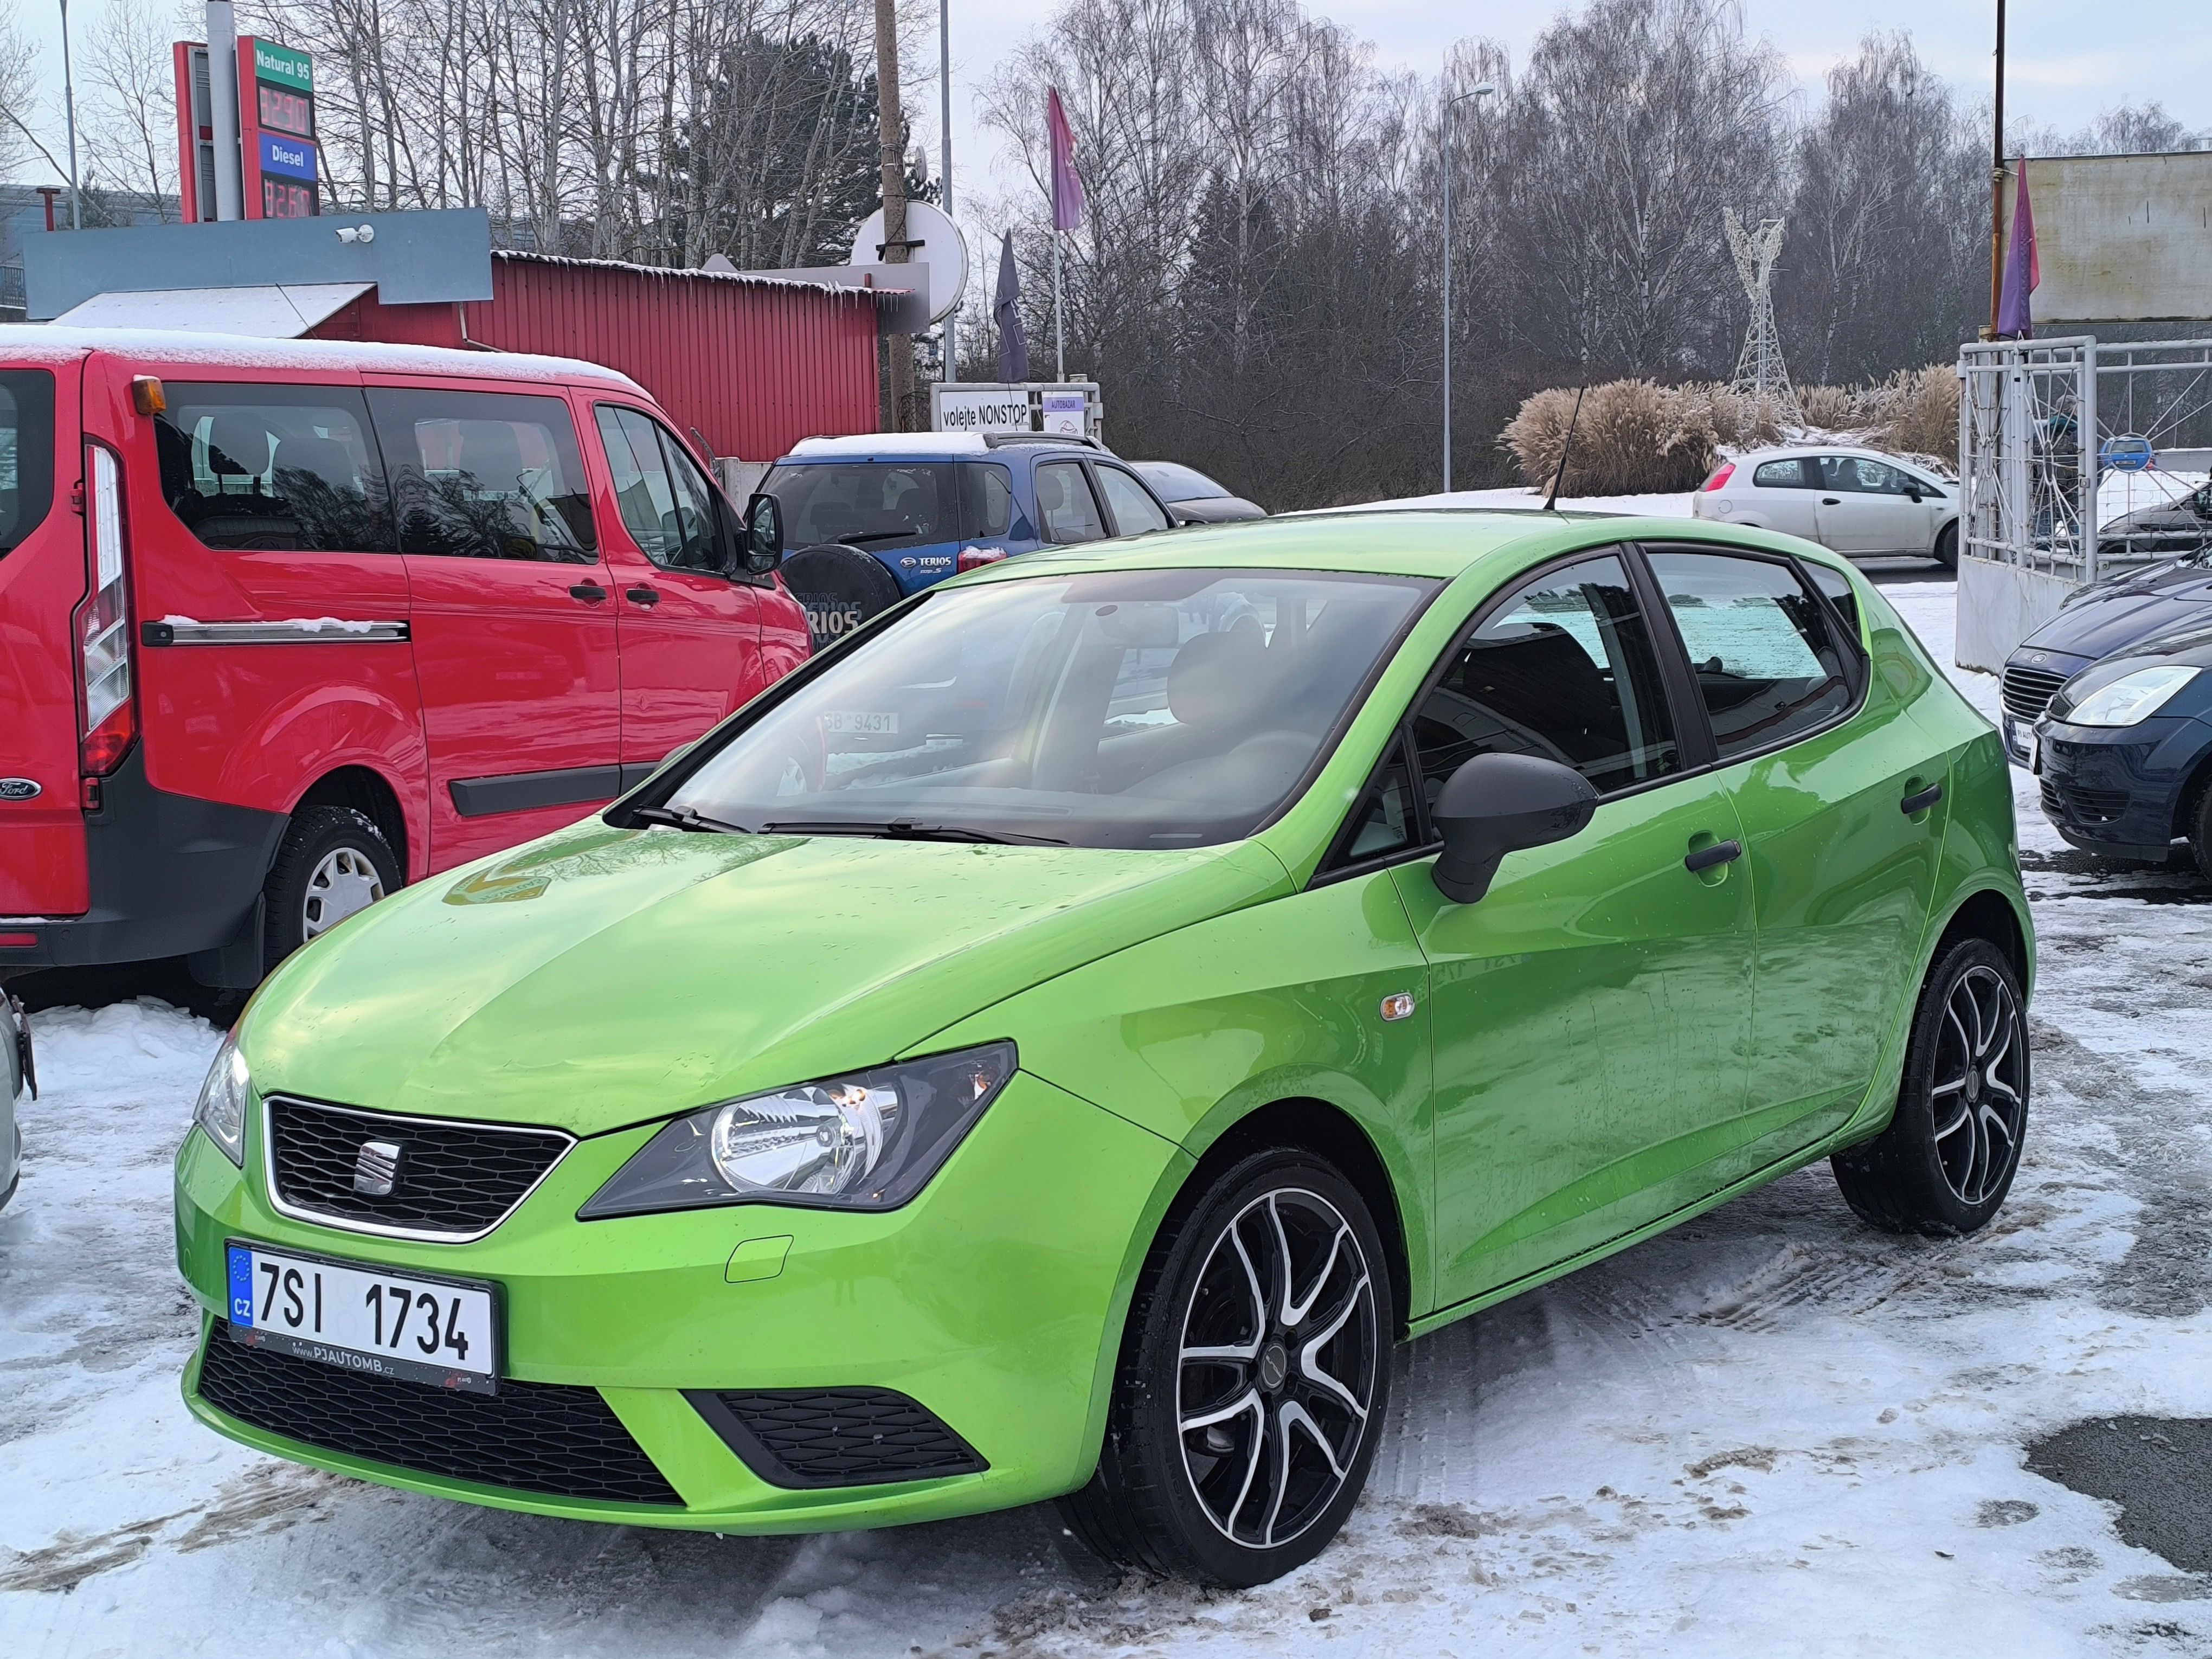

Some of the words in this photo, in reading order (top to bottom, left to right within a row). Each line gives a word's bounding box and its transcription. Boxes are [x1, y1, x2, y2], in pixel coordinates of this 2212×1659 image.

[256, 49, 294, 76] Natural
[297, 62, 310, 80] 95
[272, 144, 304, 167] Diesel
[1051, 400, 1076, 409] AUTOBAZAR
[943, 405, 976, 431] volejte
[979, 404, 1027, 425] NONSTOP
[918, 556, 951, 567] TERIOS
[807, 610, 859, 634] RIOS
[854, 714, 890, 731] 9431
[1, 782, 28, 794] Ford
[234, 1296, 250, 1319] CZ
[260, 1261, 321, 1333] 7SI
[365, 1284, 468, 1361] 1734
